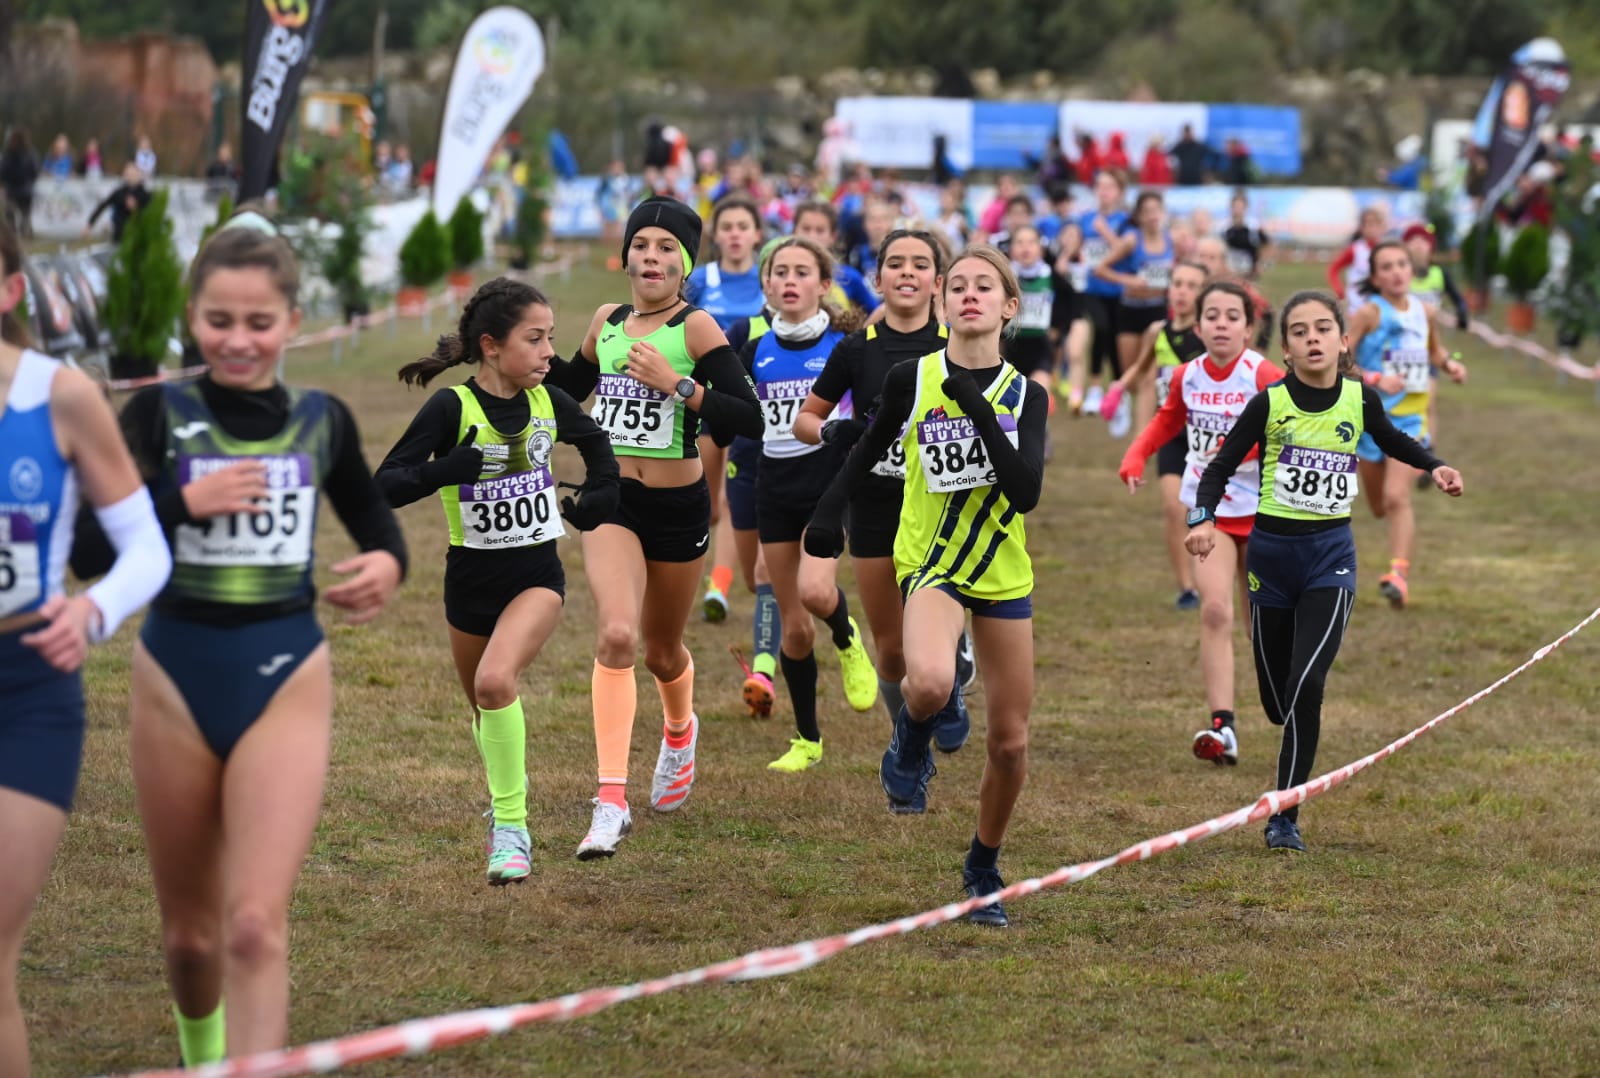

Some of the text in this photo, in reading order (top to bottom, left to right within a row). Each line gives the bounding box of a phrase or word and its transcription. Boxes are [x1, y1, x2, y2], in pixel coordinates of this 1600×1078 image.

[600, 384, 661, 400] BURGOS
[768, 387, 807, 399] BURG
[596, 396, 661, 432] 3755
[767, 398, 806, 427] 37
[925, 427, 975, 443] BURG
[925, 438, 986, 476] 384
[1290, 456, 1350, 472] BURGOS
[1292, 448, 1351, 464] DIPUTACIÓN
[473, 469, 544, 491] DIPUTACIÓN
[473, 479, 545, 501] BURGOS
[1283, 466, 1348, 500] 3819
[202, 493, 298, 538] 165
[471, 492, 550, 533] 3800
